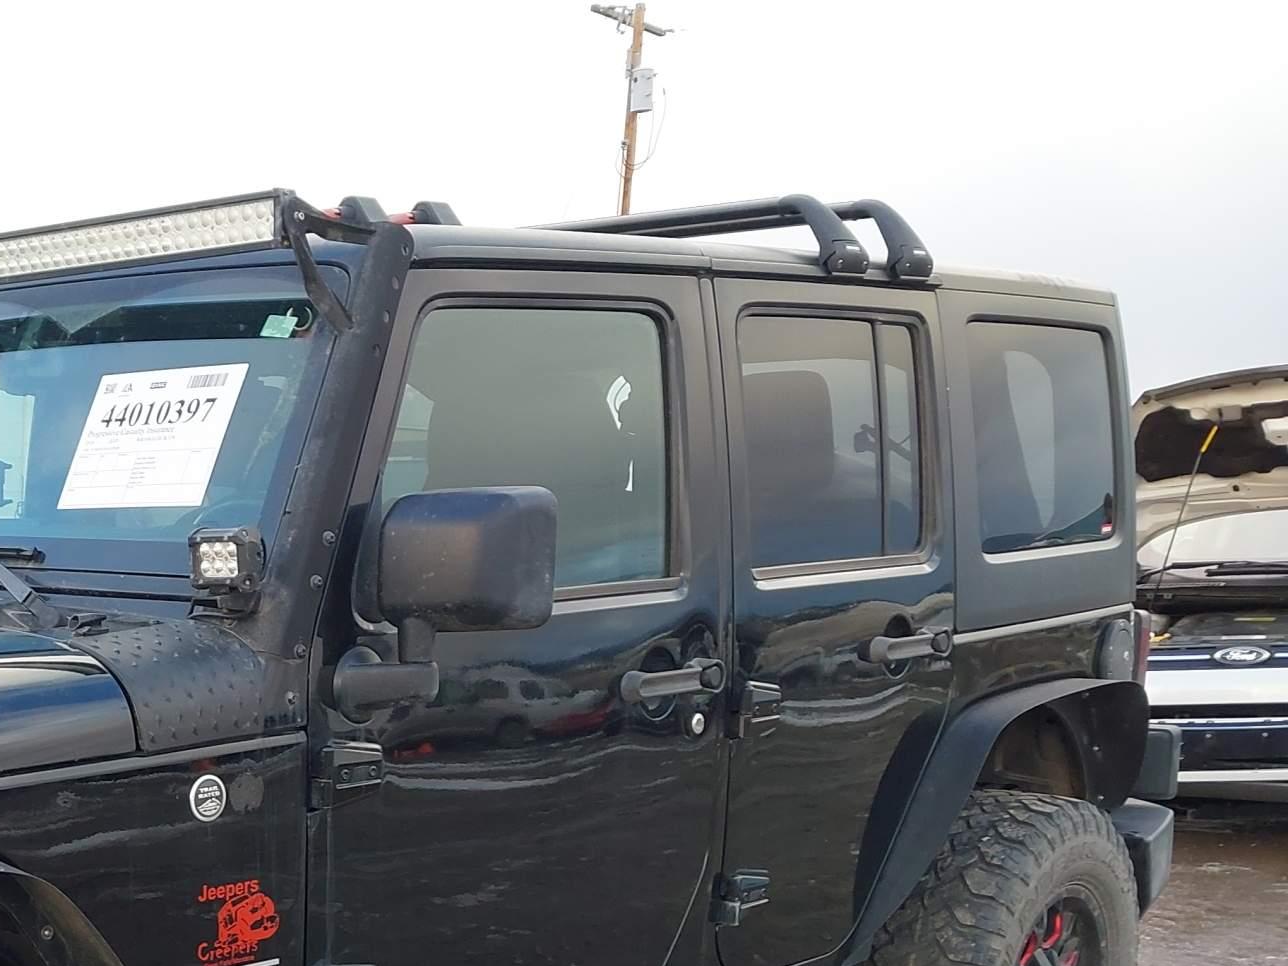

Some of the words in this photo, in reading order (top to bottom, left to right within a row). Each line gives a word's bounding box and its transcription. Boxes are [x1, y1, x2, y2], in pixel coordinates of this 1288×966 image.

[100, 396, 218, 428] 44010397
[198, 785, 220, 794] TRAIL
[198, 791, 221, 800] RATED
[198, 879, 261, 902] Jeepers
[197, 940, 259, 962] Creepers
